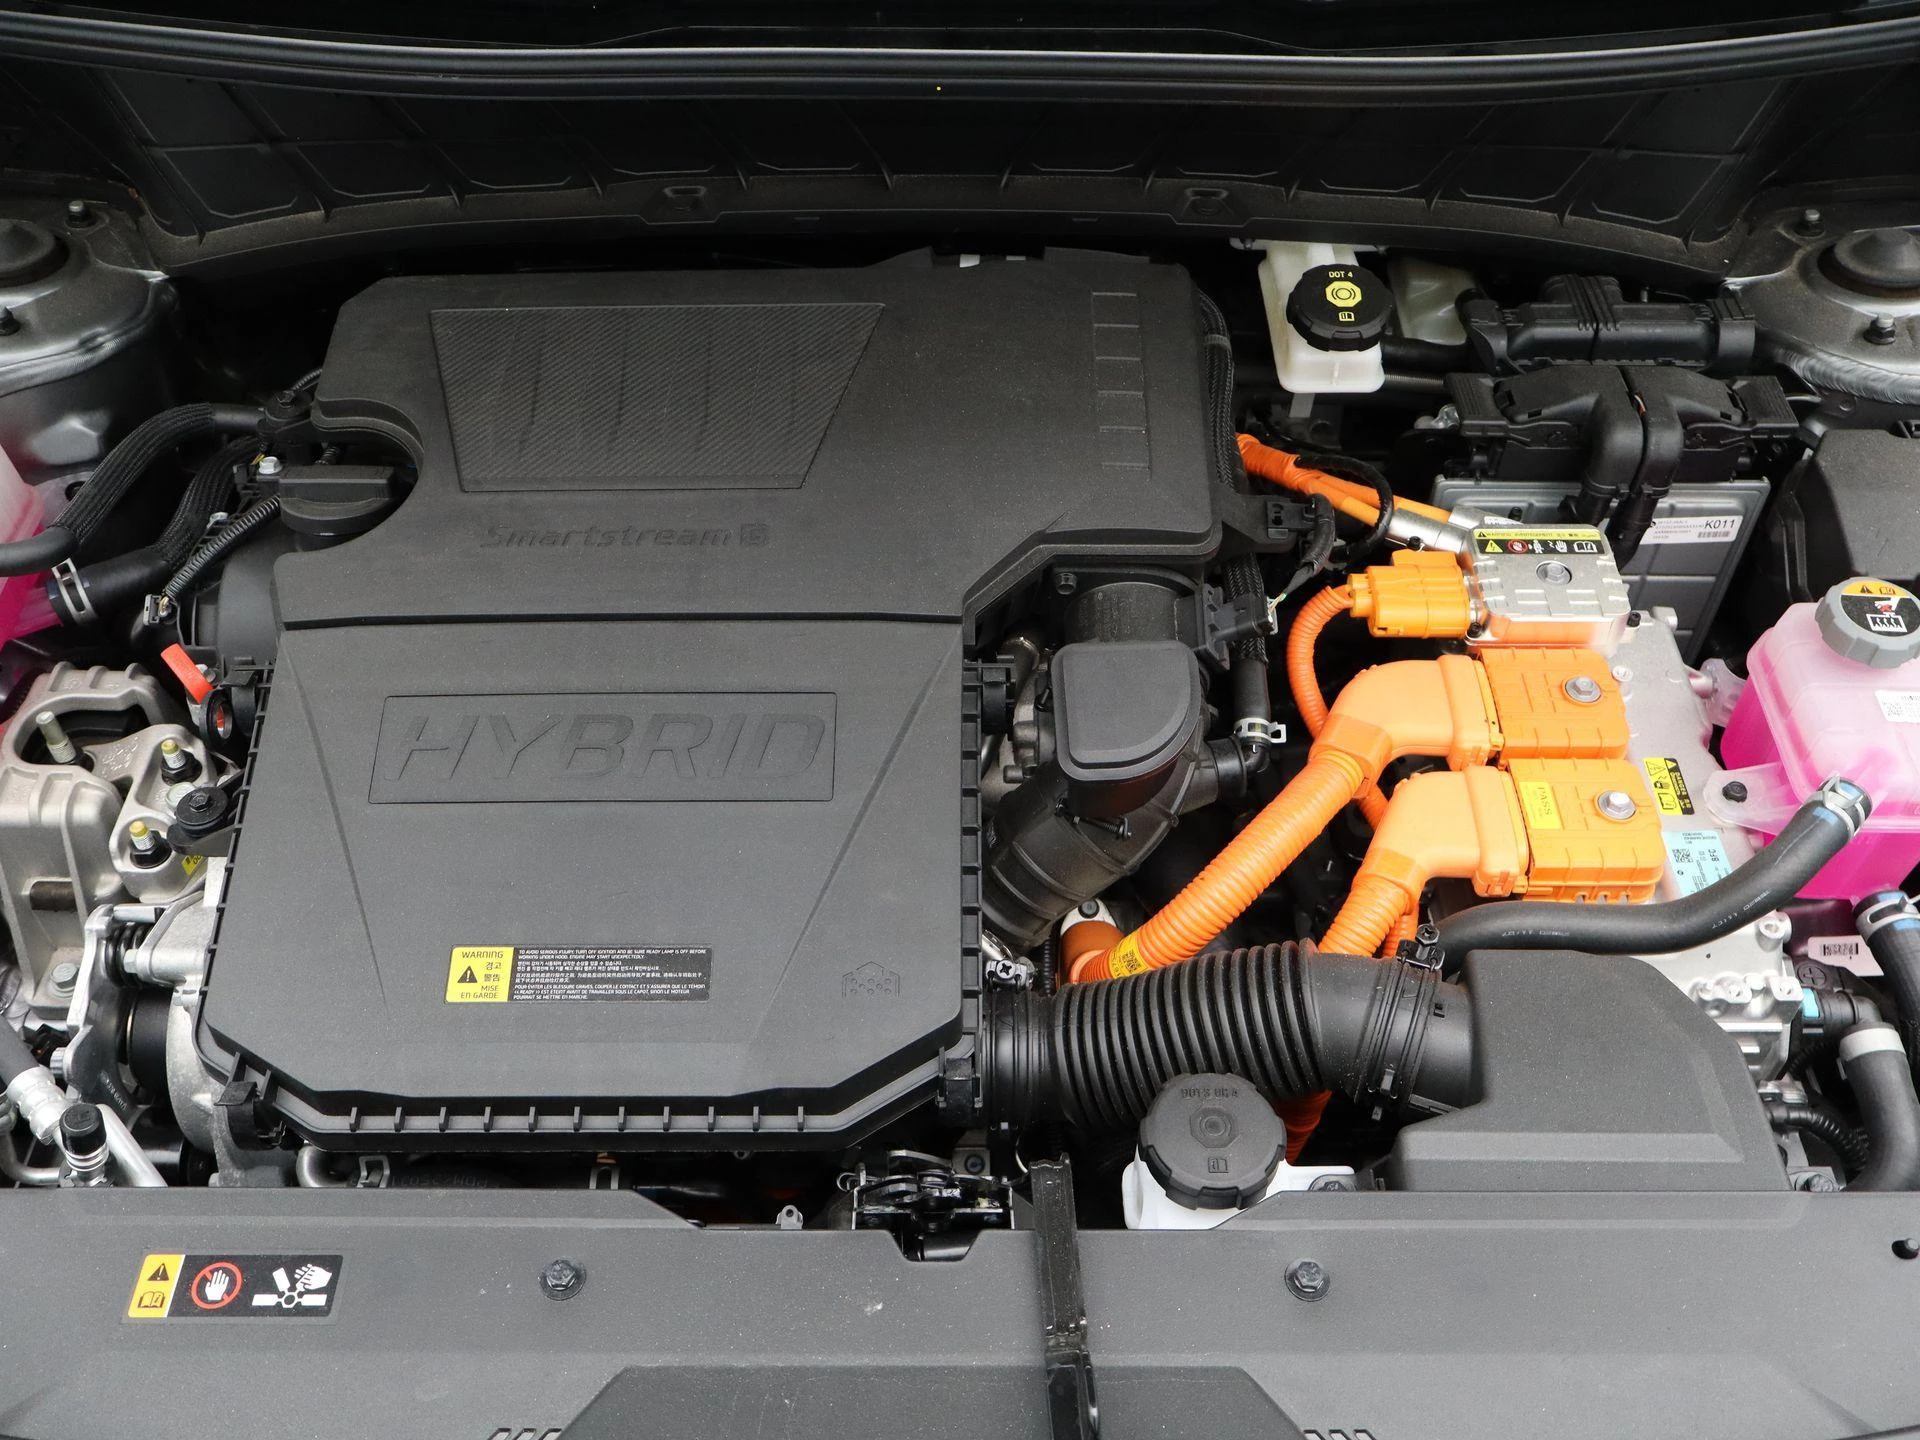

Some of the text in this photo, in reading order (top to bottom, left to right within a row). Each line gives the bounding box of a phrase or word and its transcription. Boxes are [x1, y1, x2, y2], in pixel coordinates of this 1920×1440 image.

[1704, 519, 1736, 530] K011
[479, 525, 732, 549] Smartstream
[382, 712, 827, 782] HYBRID
[461, 950, 504, 959] WARNING
[486, 962, 502, 971] 경고
